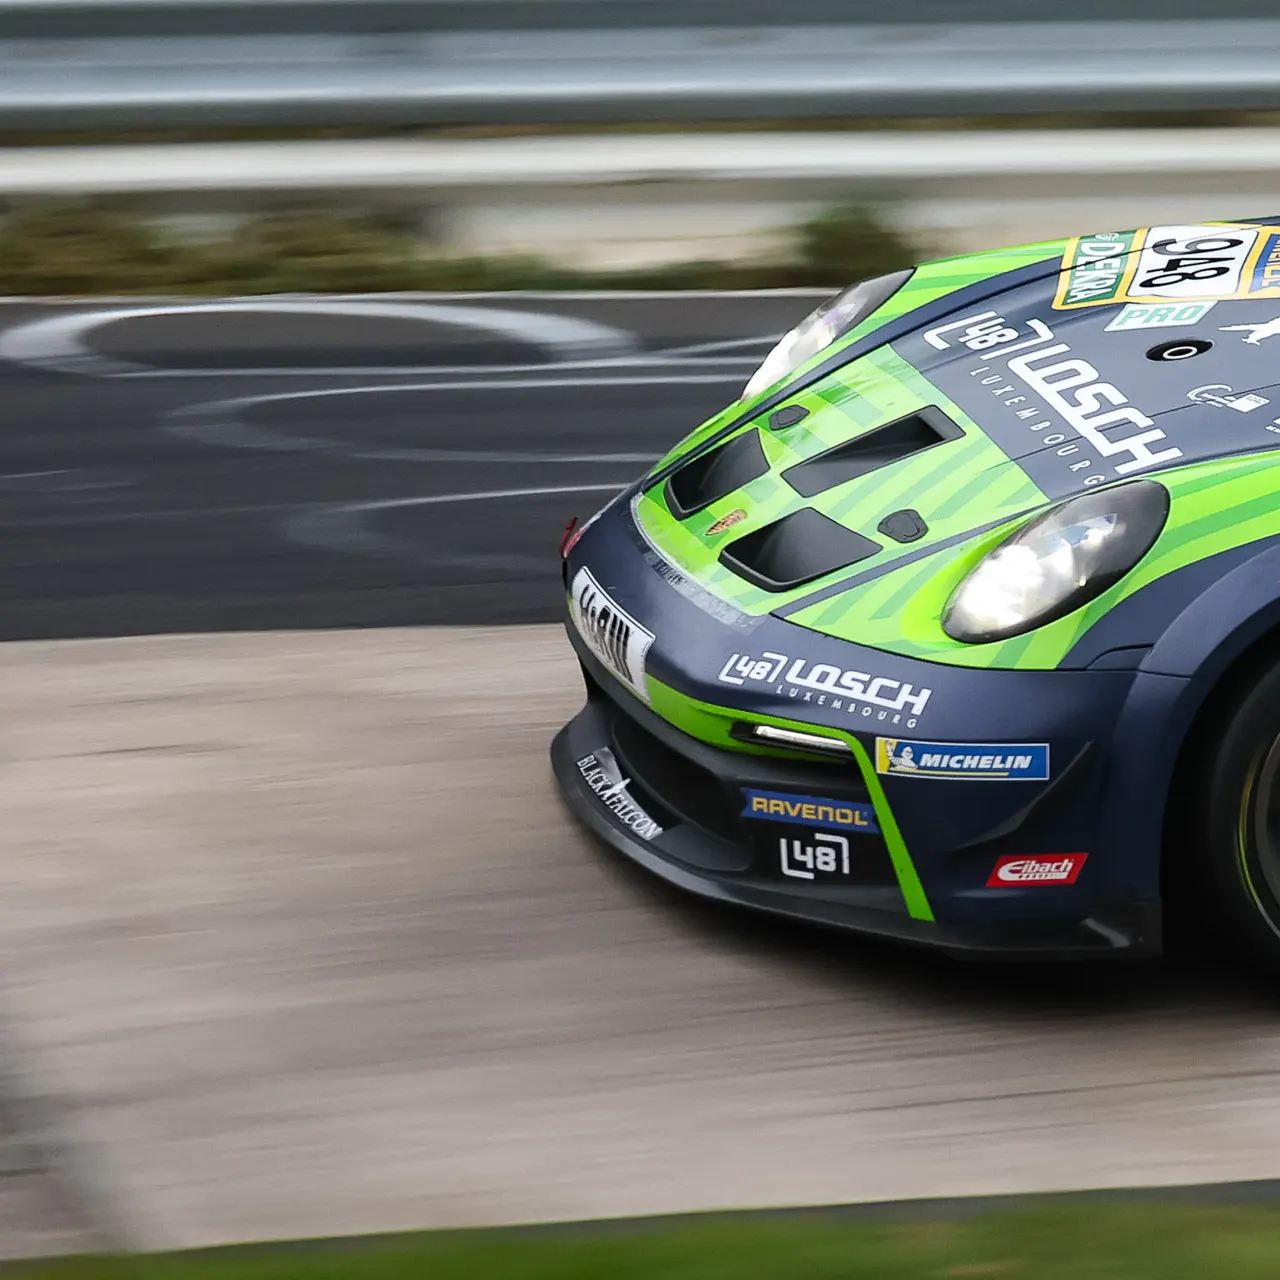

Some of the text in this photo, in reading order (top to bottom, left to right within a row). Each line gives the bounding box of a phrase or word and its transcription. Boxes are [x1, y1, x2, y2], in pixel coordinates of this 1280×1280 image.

[1066, 241, 1125, 304] DEKRA
[1139, 238, 1244, 288] 948
[1118, 305, 1205, 326] PRO
[969, 367, 1106, 487] LUXEMBOURG
[1008, 344, 1184, 475] LOSCH
[775, 684, 918, 729] LUXEMBOURG
[785, 658, 933, 716] LOSCH
[919, 753, 1033, 769] MICHELIN
[577, 755, 664, 840] BLACK FALCON
[751, 797, 869, 826] RAVENOL
[997, 858, 1075, 882] Eibach
